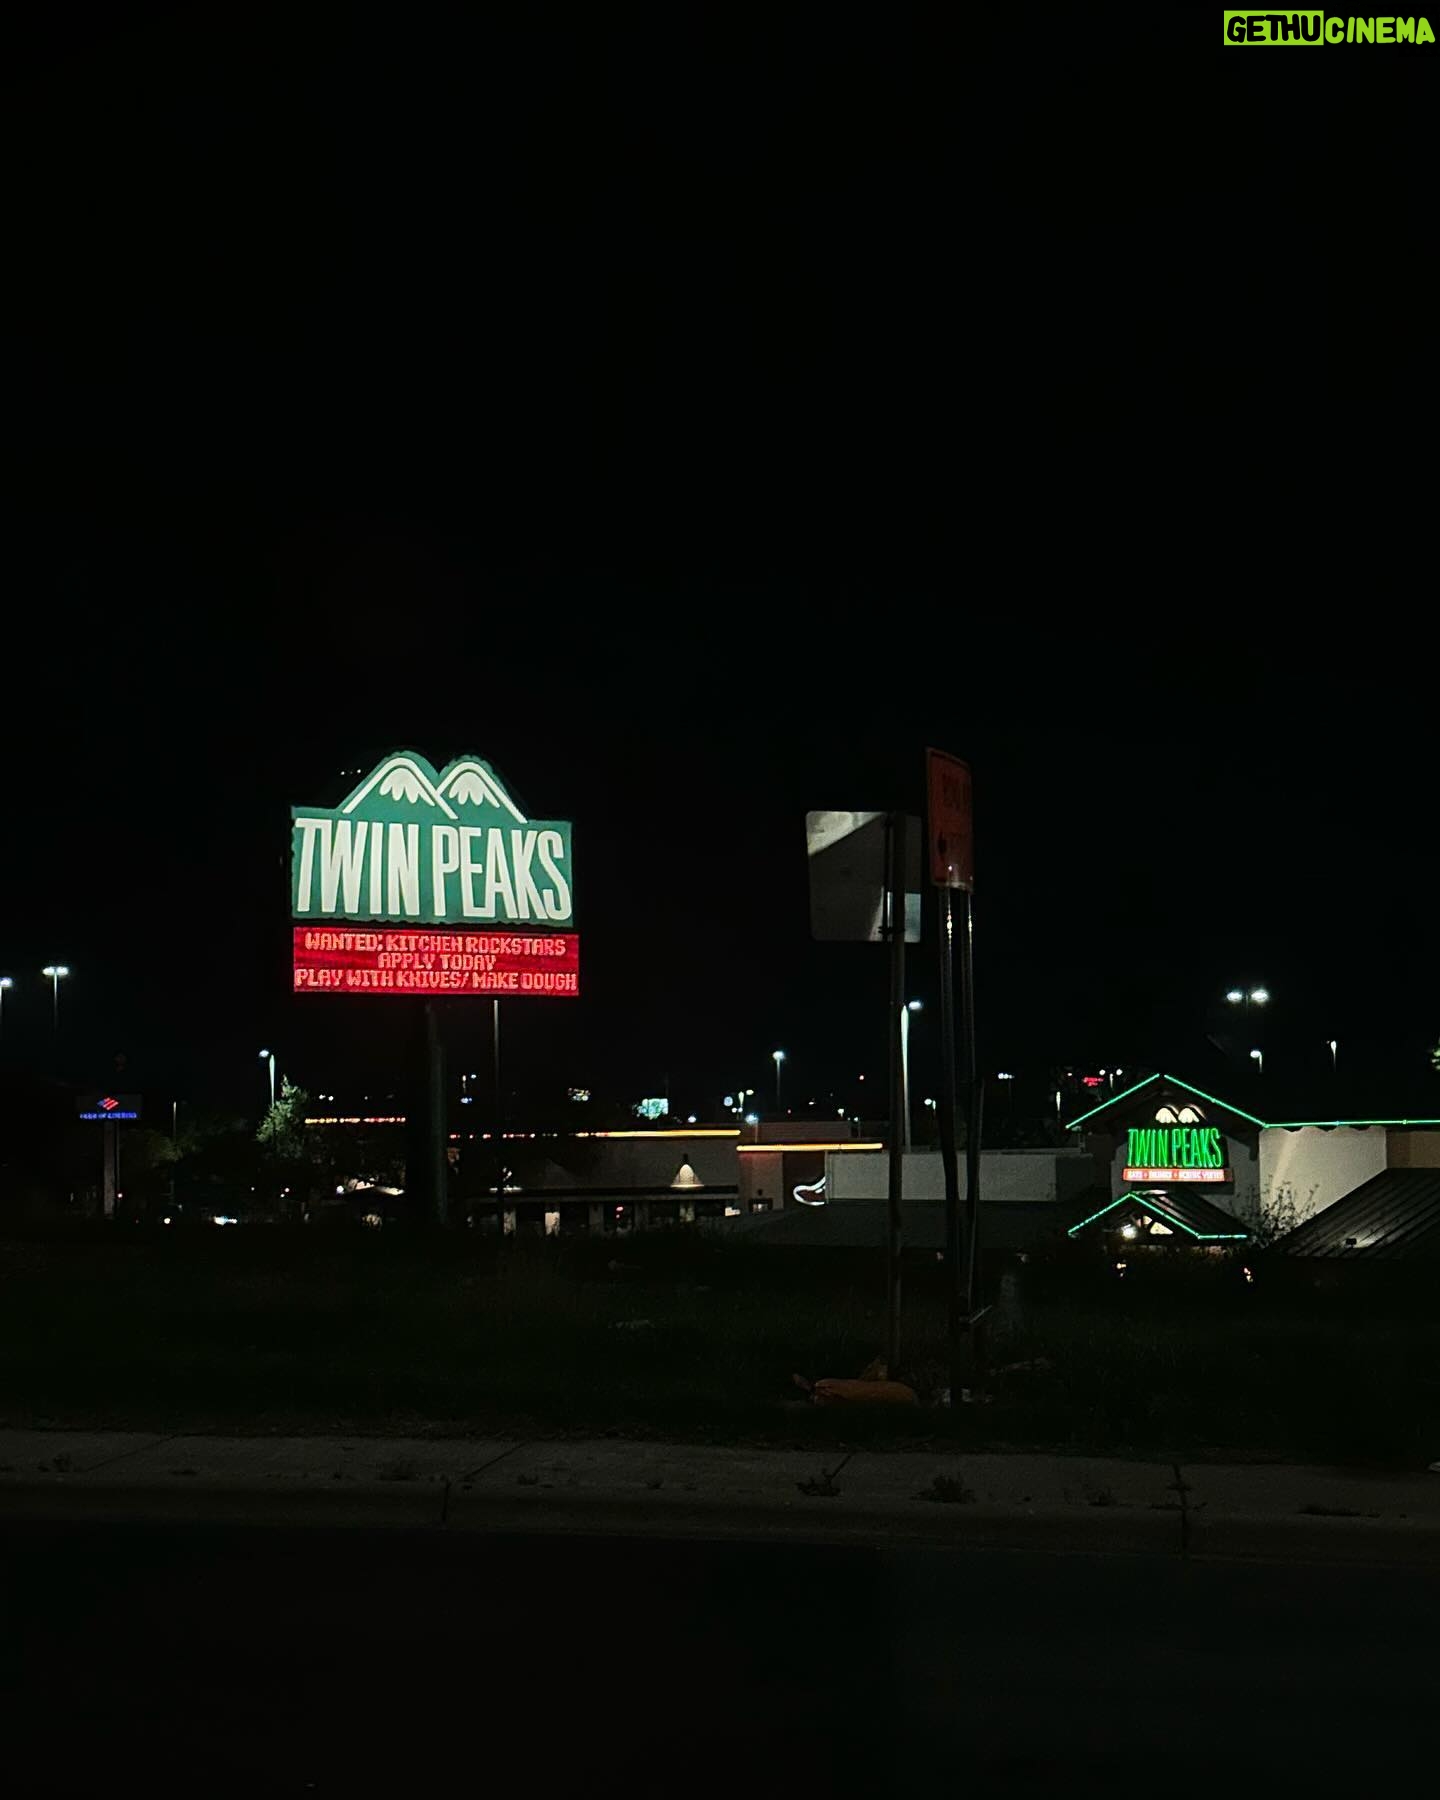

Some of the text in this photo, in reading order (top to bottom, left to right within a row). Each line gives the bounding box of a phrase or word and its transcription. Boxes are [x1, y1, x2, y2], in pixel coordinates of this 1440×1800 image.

[295, 817, 572, 921] TWIN PEAKS
[386, 935, 462, 953] KITCHEN
[465, 936, 566, 956] ROCKSTARS
[378, 952, 497, 971] APPLY TODAY
[295, 968, 343, 987] PLAY
[346, 969, 394, 987] WITH
[472, 972, 519, 989] MAKE
[521, 973, 577, 991] DOUGH
[1127, 1128, 1224, 1169] TWIN PEAKS
